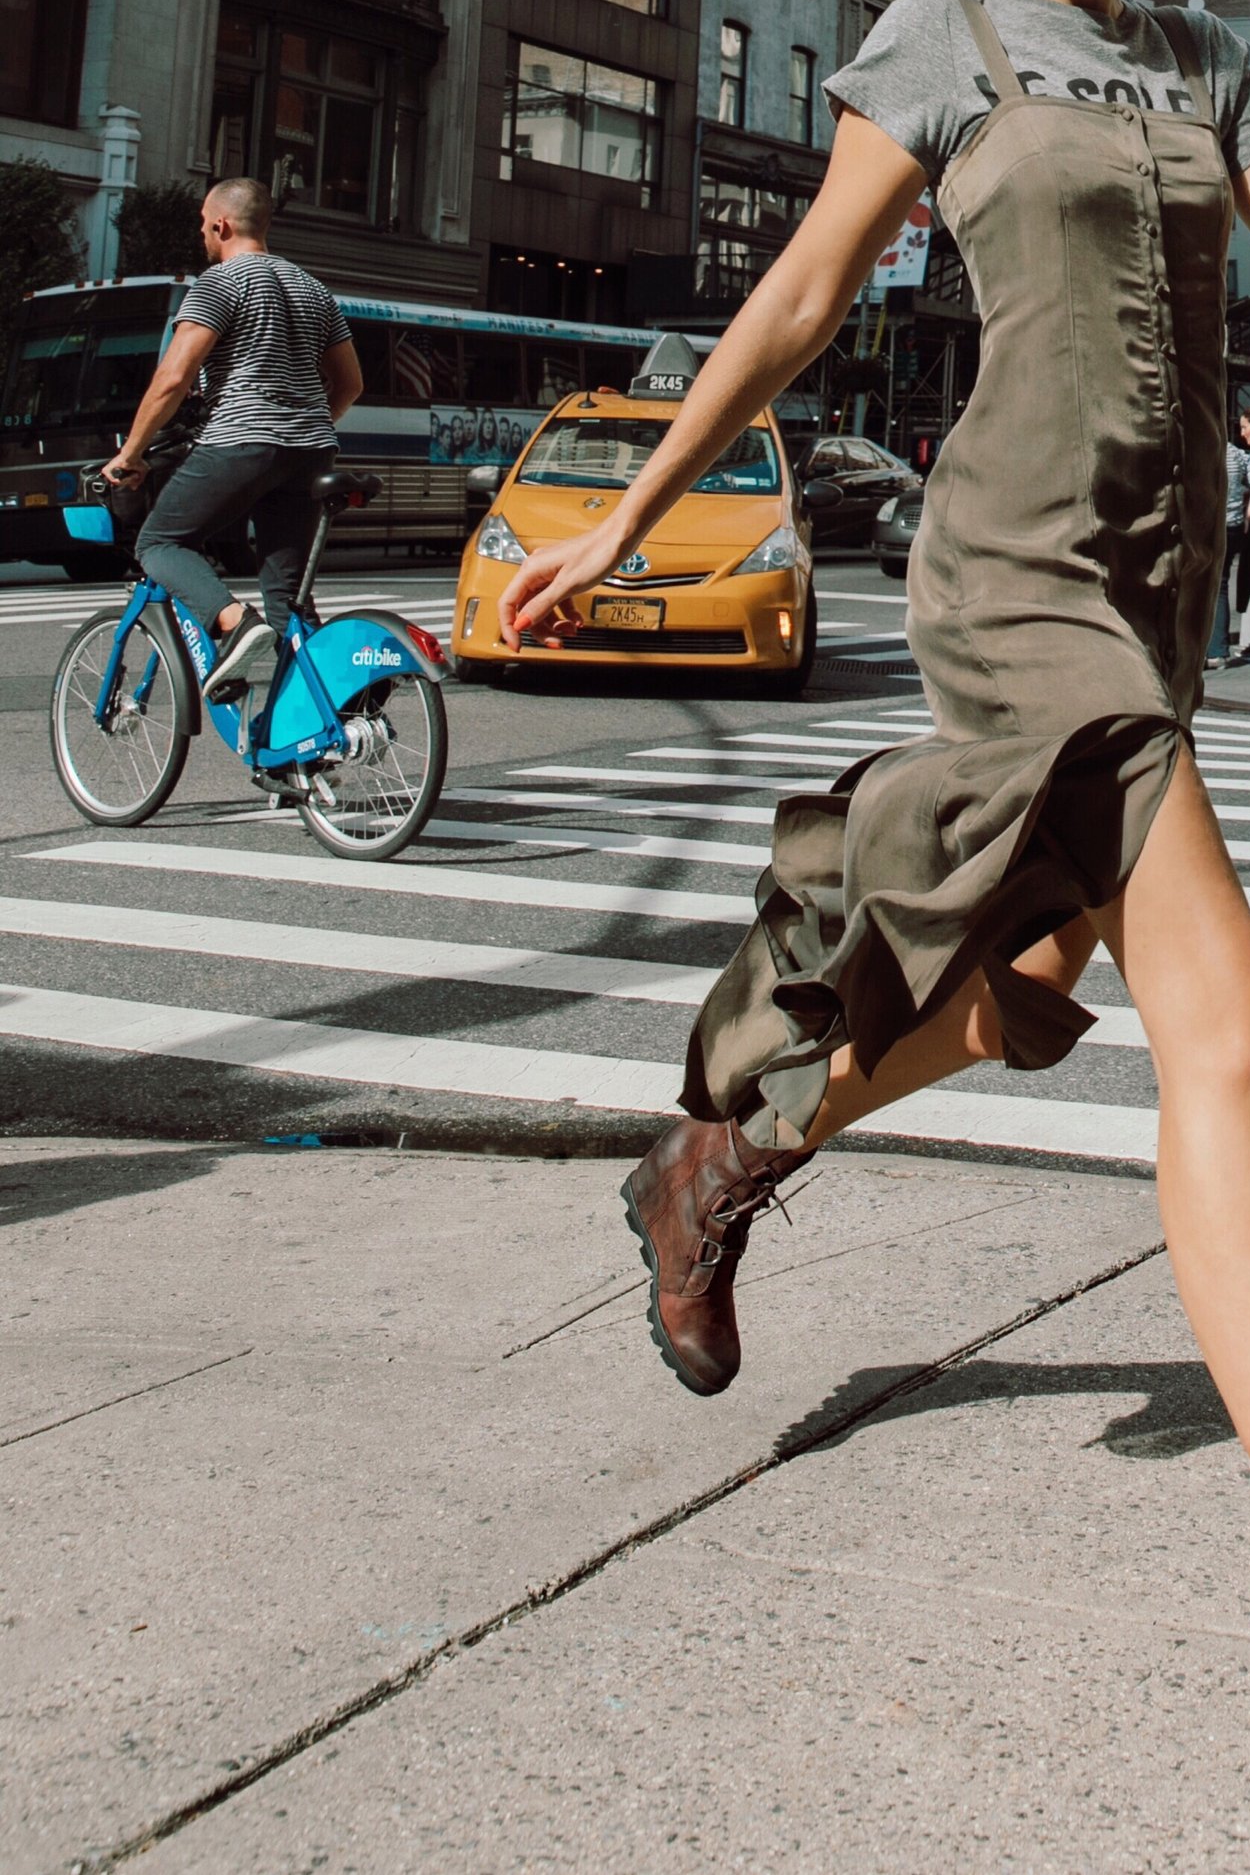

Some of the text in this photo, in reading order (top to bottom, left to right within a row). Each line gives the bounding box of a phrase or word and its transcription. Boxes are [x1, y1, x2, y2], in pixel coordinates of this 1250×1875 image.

[339, 300, 400, 318] ANIFEST
[650, 376, 684, 390] 2K45
[183, 619, 208, 680] citi bike
[352, 648, 401, 667] citi bike
